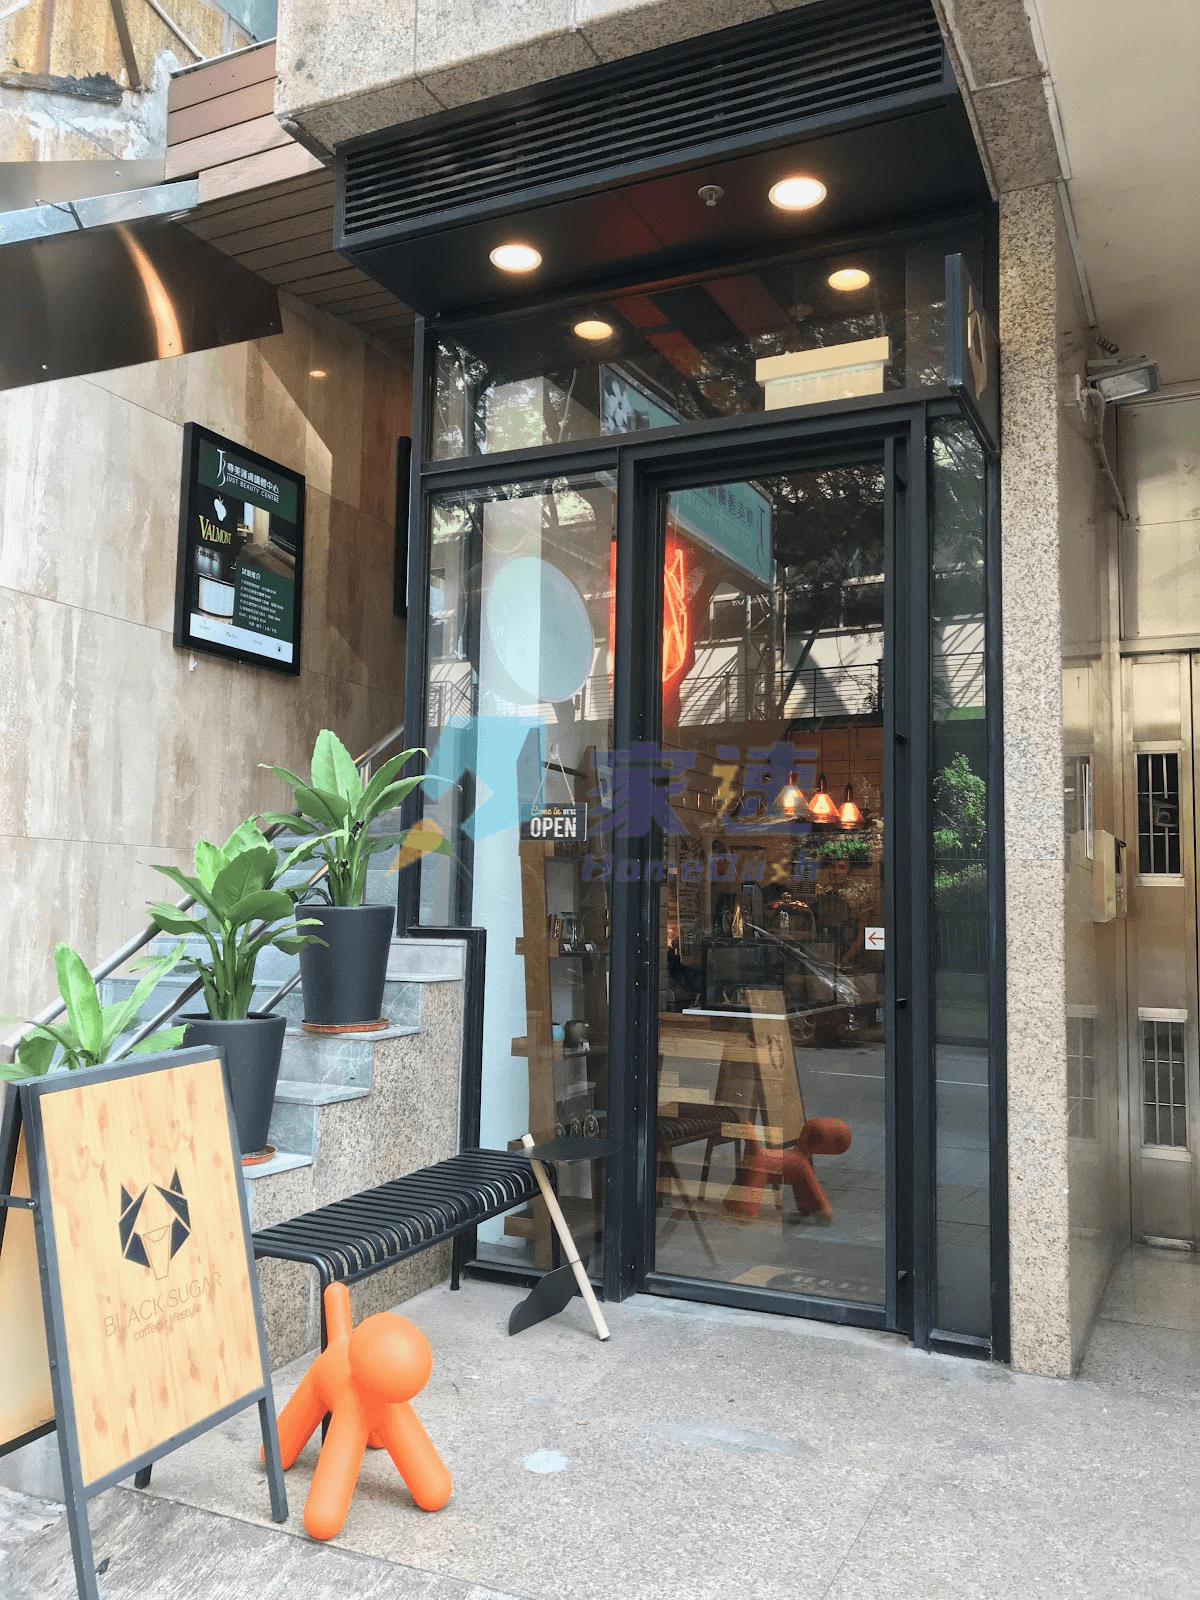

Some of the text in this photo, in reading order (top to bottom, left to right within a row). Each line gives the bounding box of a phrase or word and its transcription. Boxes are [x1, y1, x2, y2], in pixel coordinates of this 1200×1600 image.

[226, 475, 279, 503] JUST BEAUTY CENTRE
[199, 514, 232, 545] VALMONT
[530, 805, 552, 817] Come
[715, 797, 768, 811] BLACK
[530, 816, 577, 838] OPEN
[103, 1271, 222, 1338] BLACK SUGAR
[169, 1303, 202, 1325] lifestyle
